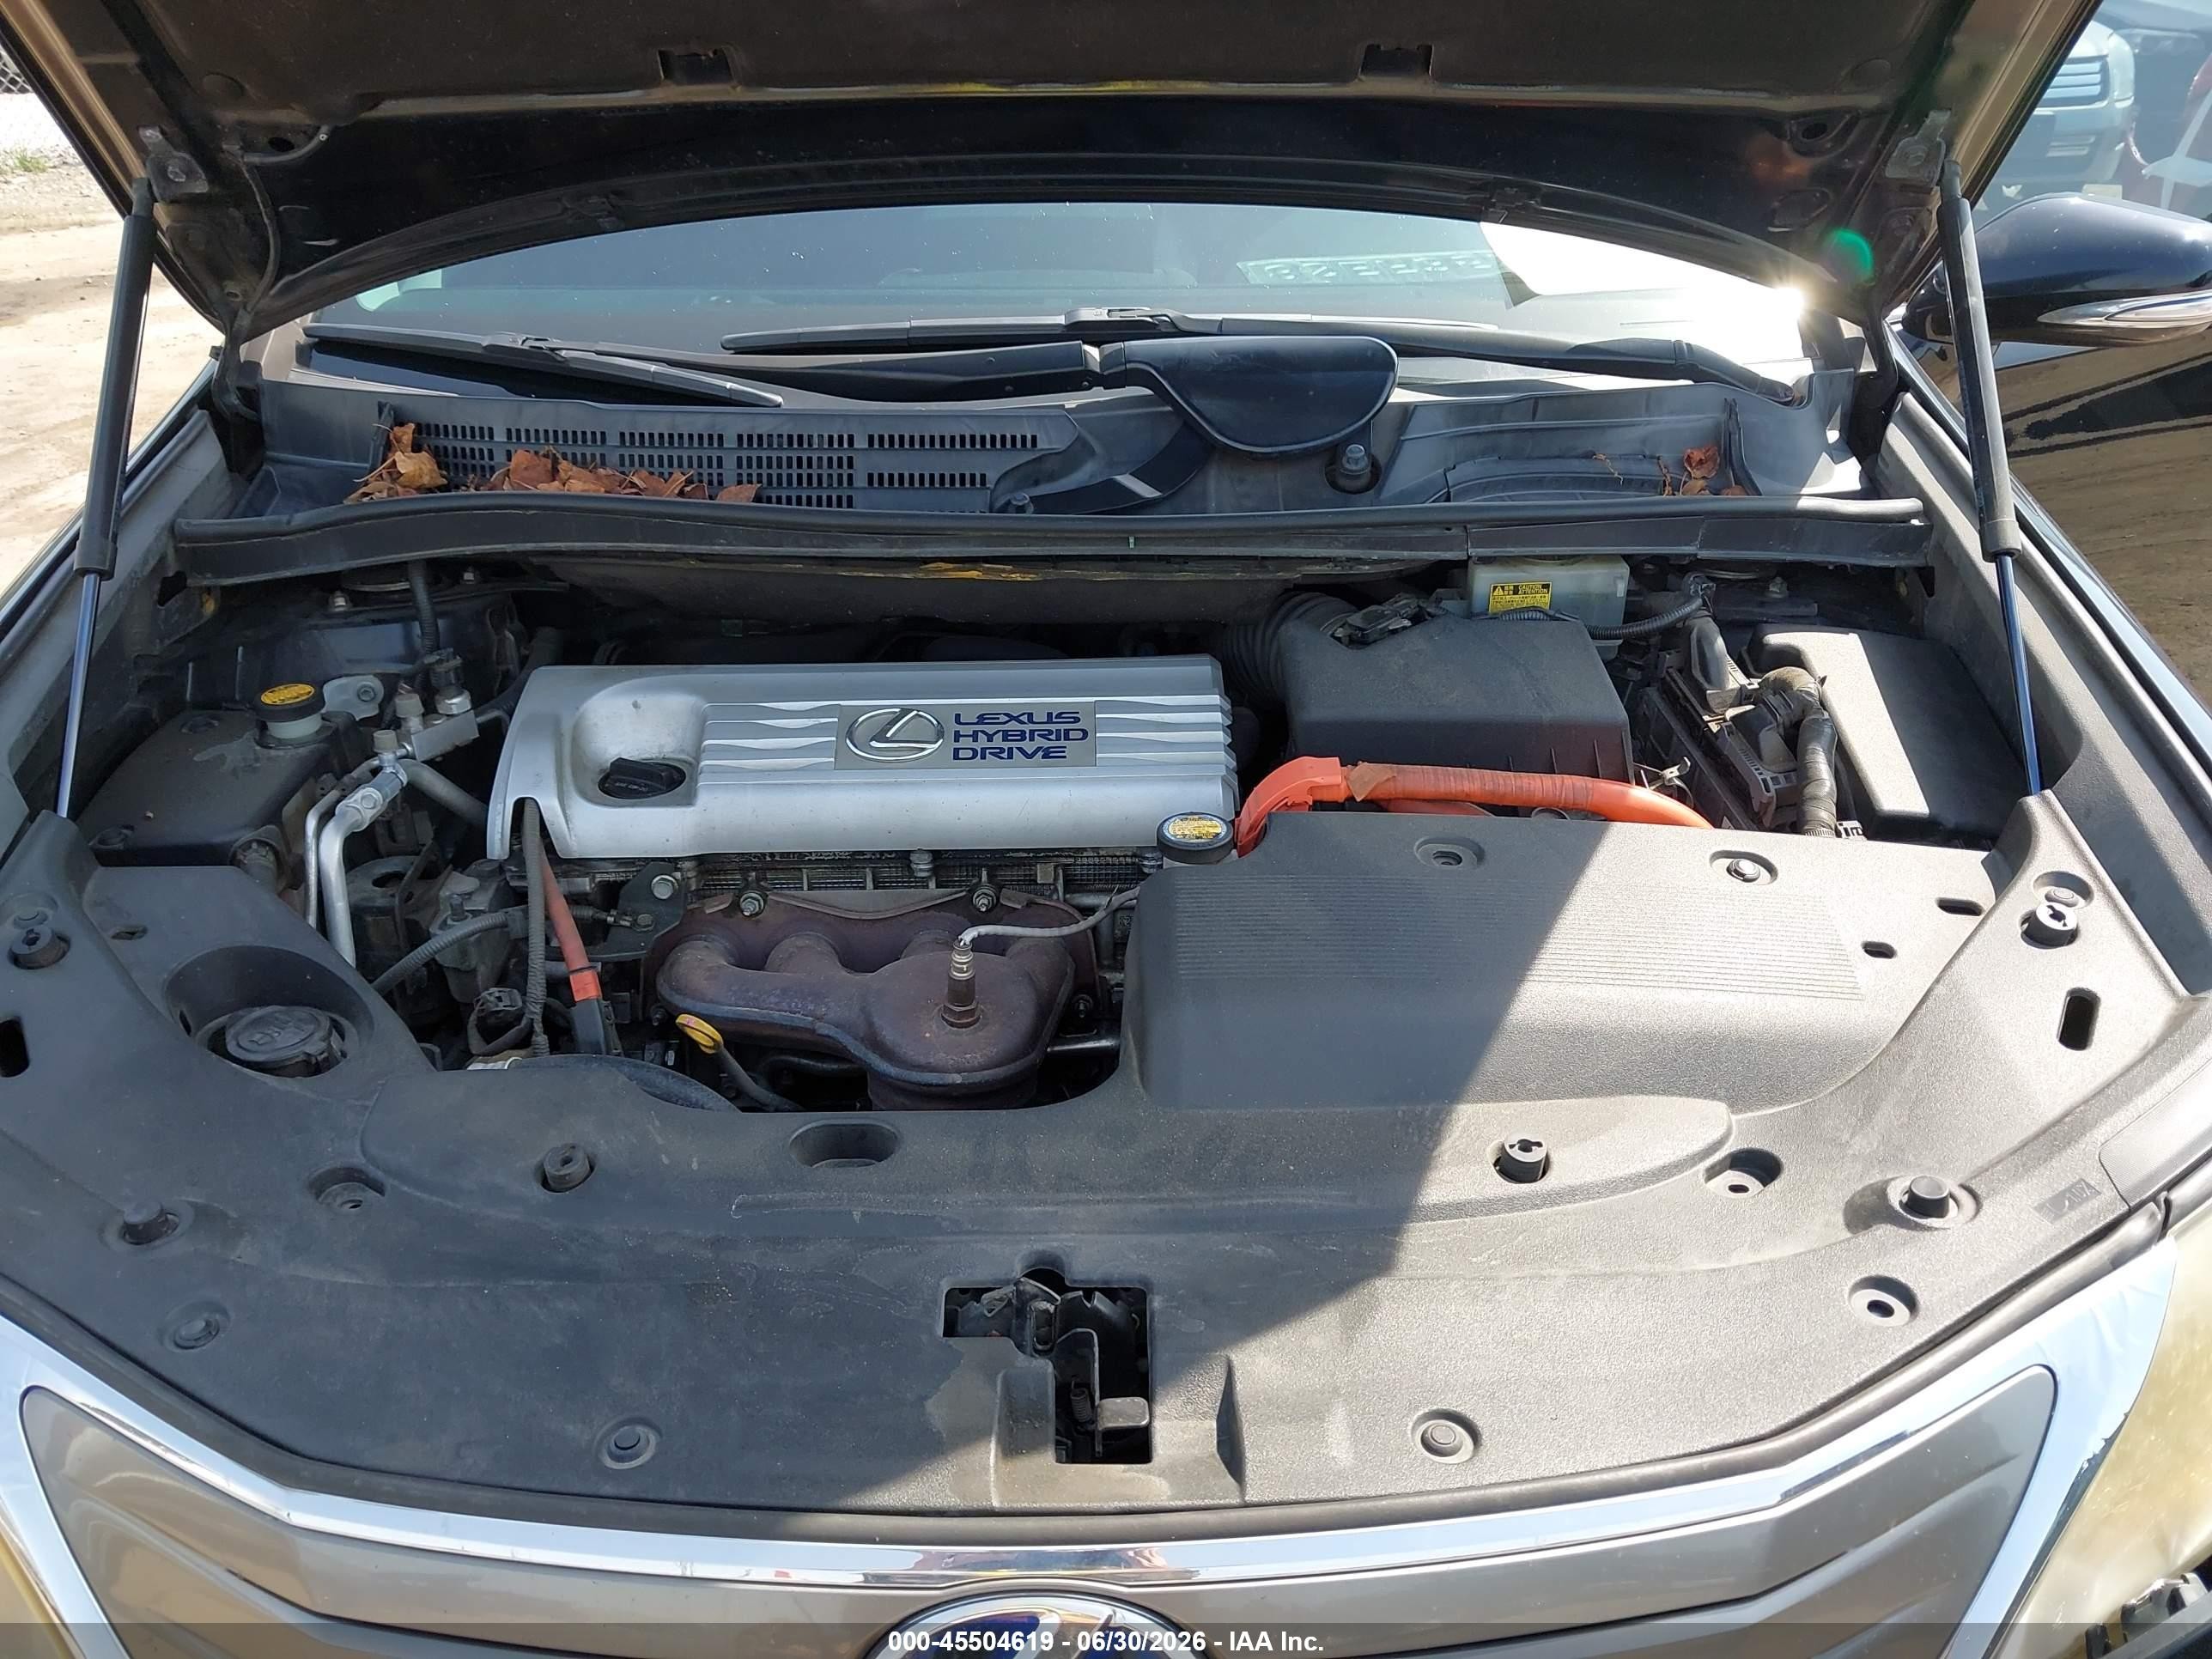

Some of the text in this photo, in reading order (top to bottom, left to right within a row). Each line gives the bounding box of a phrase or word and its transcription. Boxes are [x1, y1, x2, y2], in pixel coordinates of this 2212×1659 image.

[954, 711, 1081, 726] LEXUS
[953, 728, 1089, 743] HYBRID
[952, 745, 1067, 761] DRIVE
